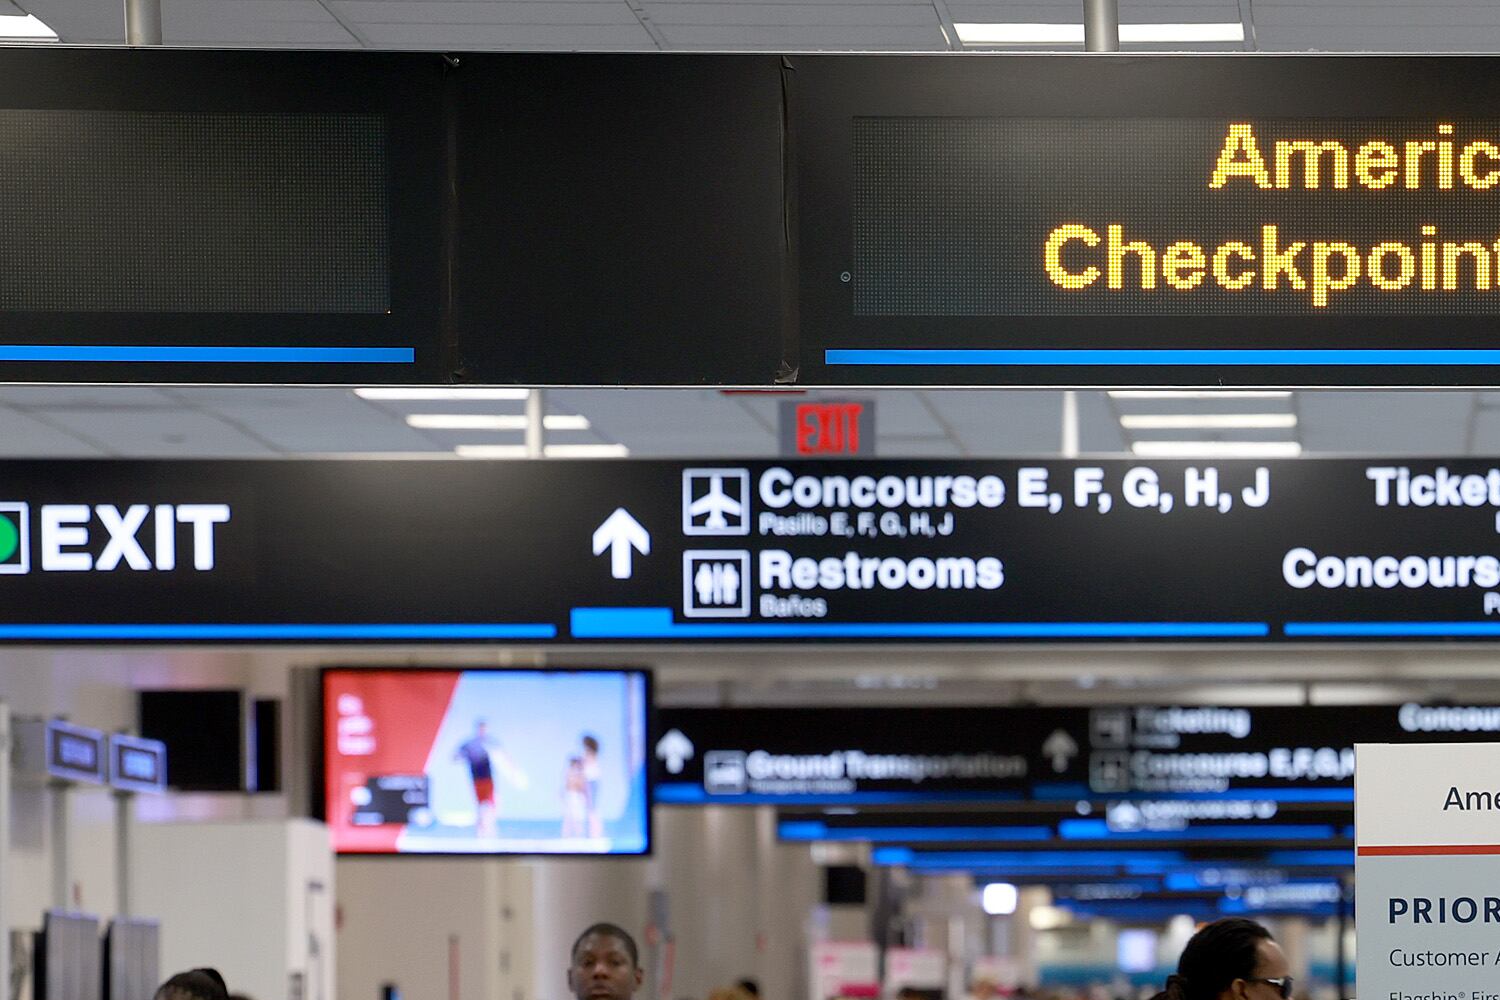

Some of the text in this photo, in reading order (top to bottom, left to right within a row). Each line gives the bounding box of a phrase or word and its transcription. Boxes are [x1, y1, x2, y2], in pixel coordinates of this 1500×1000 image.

[795, 402, 864, 456] EXIT
[759, 467, 1269, 513] Concourse E, F, G, H, J
[41, 504, 230, 571] EXIT
[831, 512, 853, 536] E,
[858, 512, 877, 536] F,
[880, 512, 907, 536] G,
[910, 513, 935, 536] H,
[939, 513, 953, 535] J
[760, 550, 1004, 589] Restrooms
[760, 594, 827, 617] Baños
[1390, 949, 1489, 966] Customer
